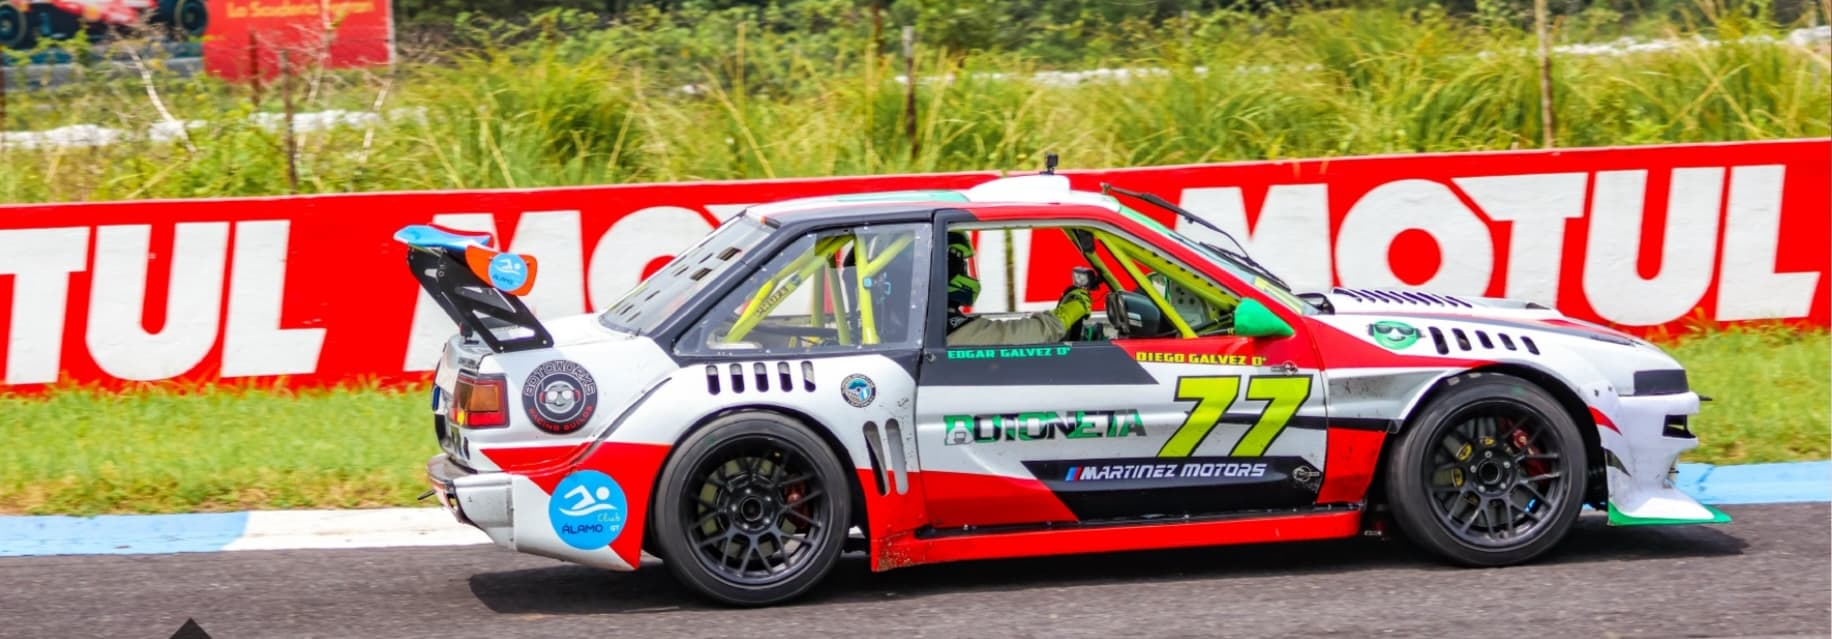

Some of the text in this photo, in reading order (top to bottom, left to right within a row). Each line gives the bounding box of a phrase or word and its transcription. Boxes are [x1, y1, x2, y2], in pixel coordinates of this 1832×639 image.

[947, 350, 996, 360] EDGAR
[999, 347, 1052, 358] GALVEZ
[1136, 352, 1185, 363] DIEGO
[1188, 353, 1247, 365] GALVEZ
[1155, 374, 1314, 459] 77
[1079, 463, 1267, 480] MARTINEZ MOTORS
